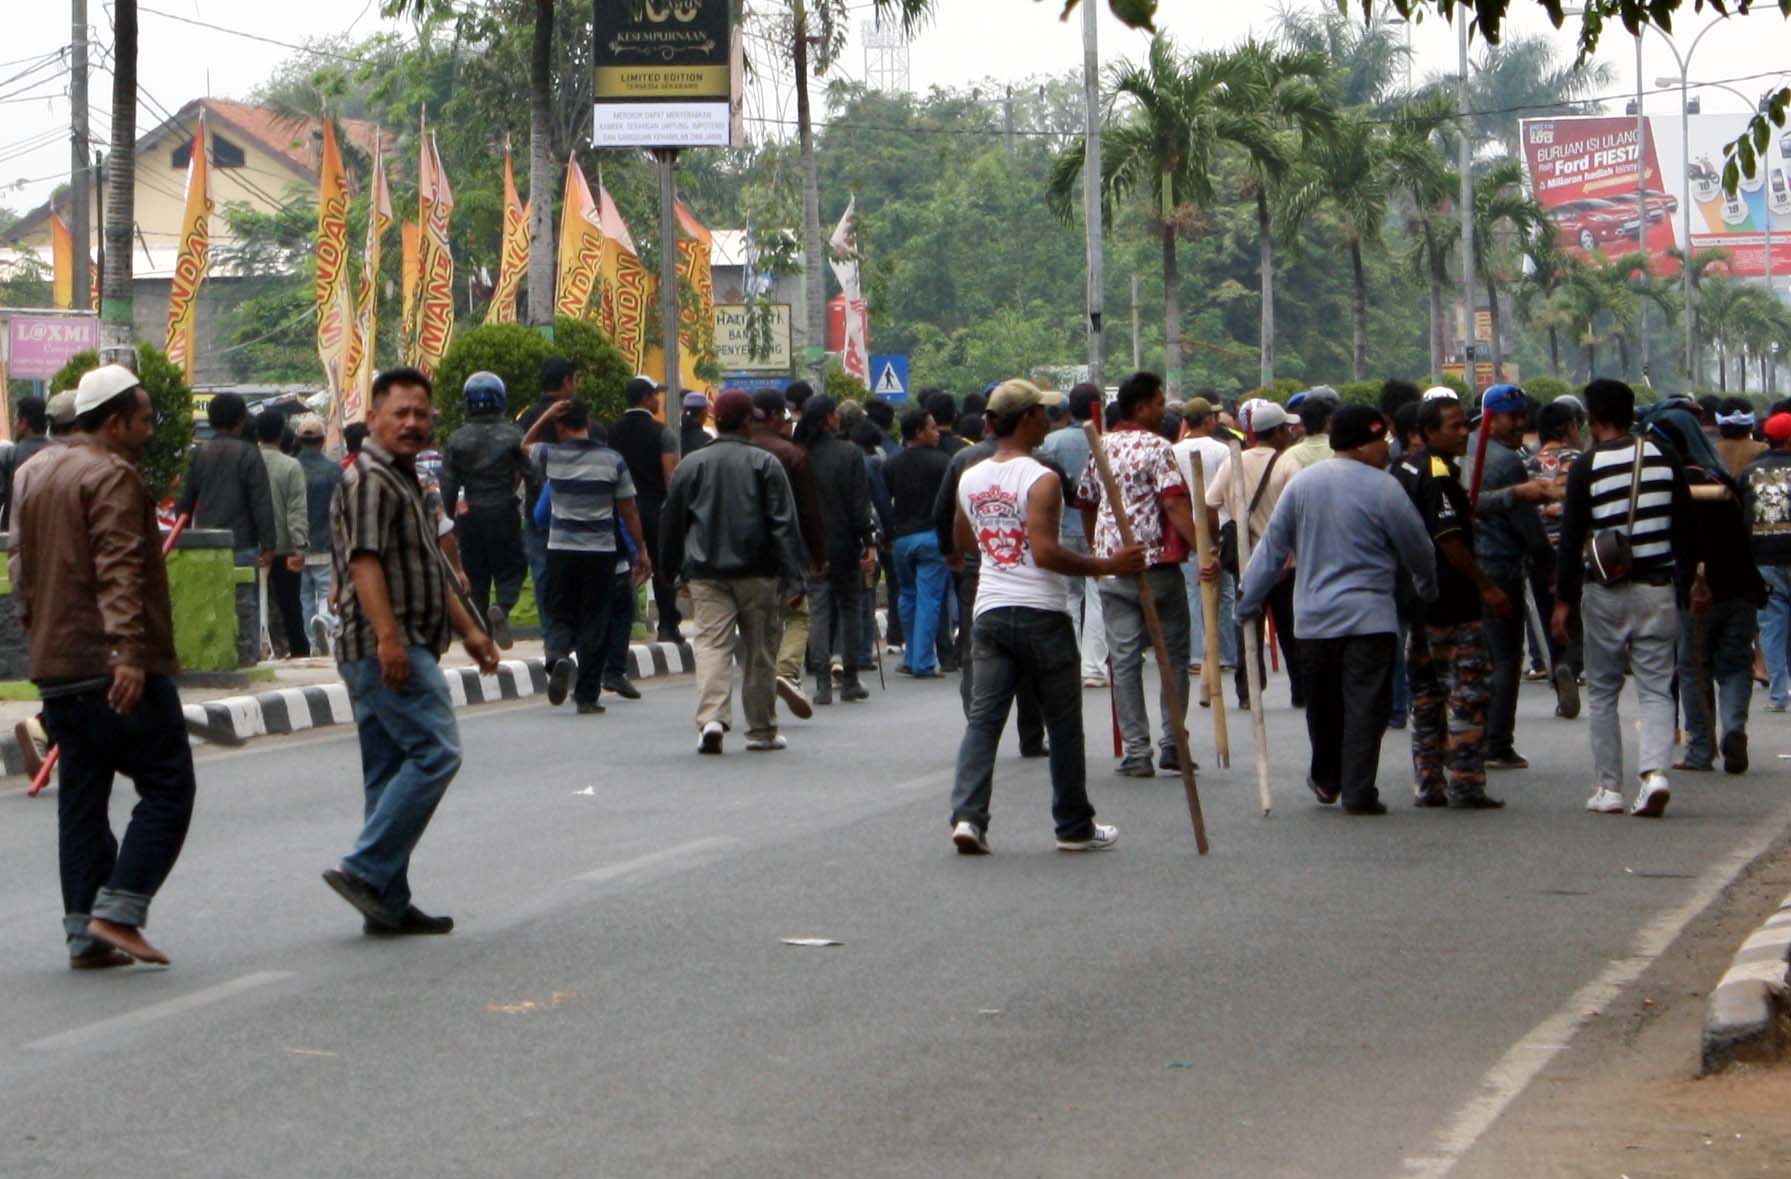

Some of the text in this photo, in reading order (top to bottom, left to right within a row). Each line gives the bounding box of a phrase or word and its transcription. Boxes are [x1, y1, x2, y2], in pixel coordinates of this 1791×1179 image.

[621, 73, 704, 82] LIMITED EDITION
[1537, 129, 1640, 162] BURUAN ISI ULANG
[1554, 155, 1590, 176] Ford
